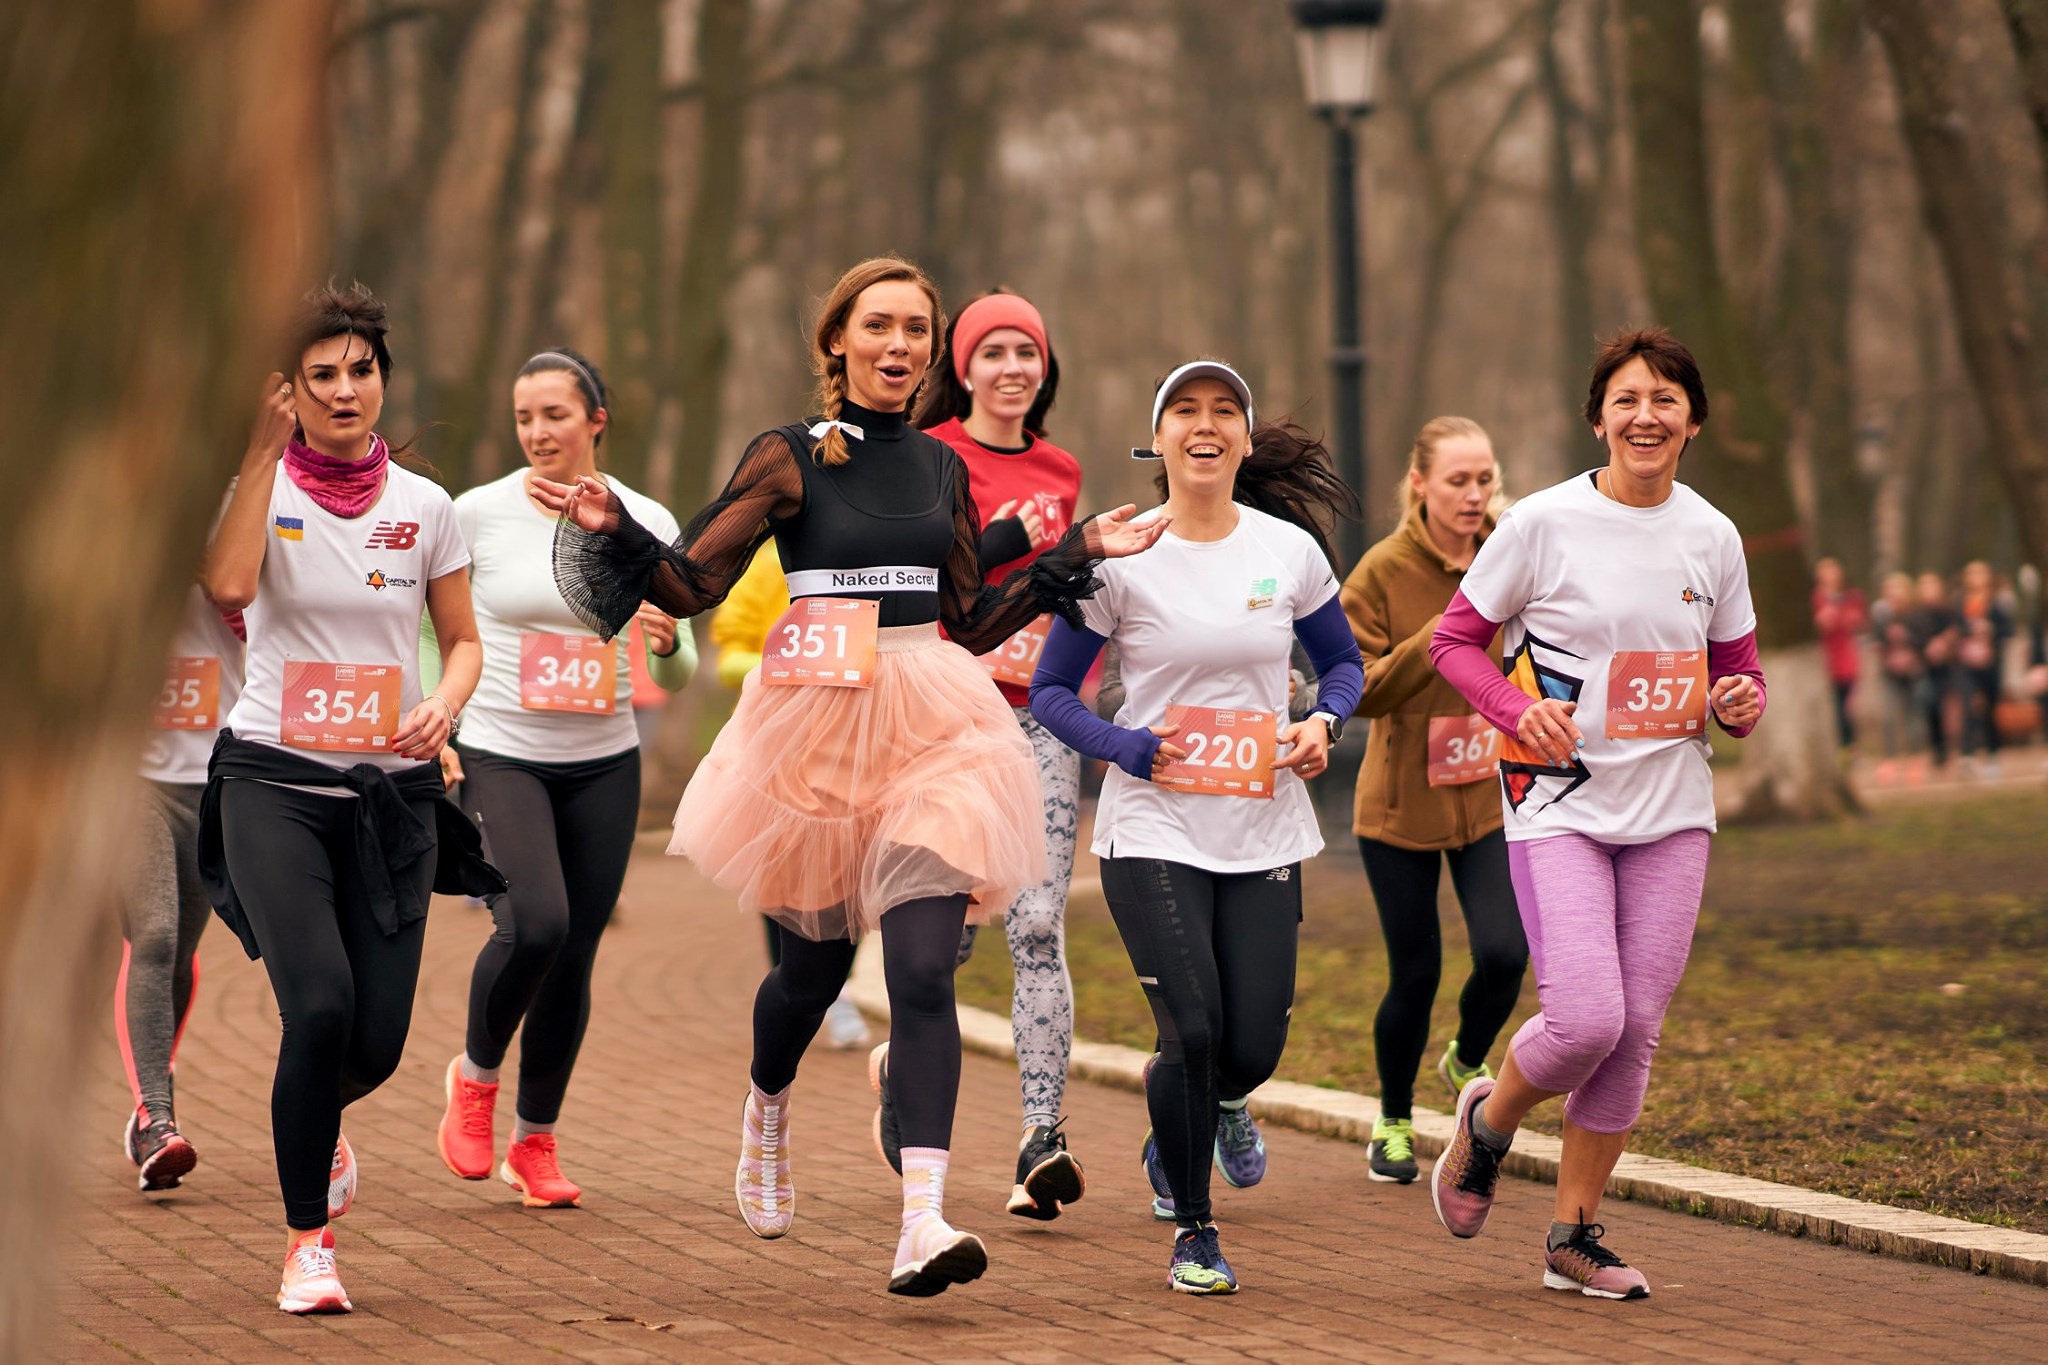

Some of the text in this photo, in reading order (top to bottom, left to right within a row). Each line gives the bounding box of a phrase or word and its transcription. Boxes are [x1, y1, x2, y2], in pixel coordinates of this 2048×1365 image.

[833, 571, 935, 587] Naked Secret
[781, 624, 847, 658] 351
[994, 630, 1044, 662] 57
[537, 656, 602, 689] 349
[158, 678, 201, 708] 55
[304, 688, 380, 725] 354
[1627, 677, 1695, 711] 357
[1184, 732, 1258, 771] 220
